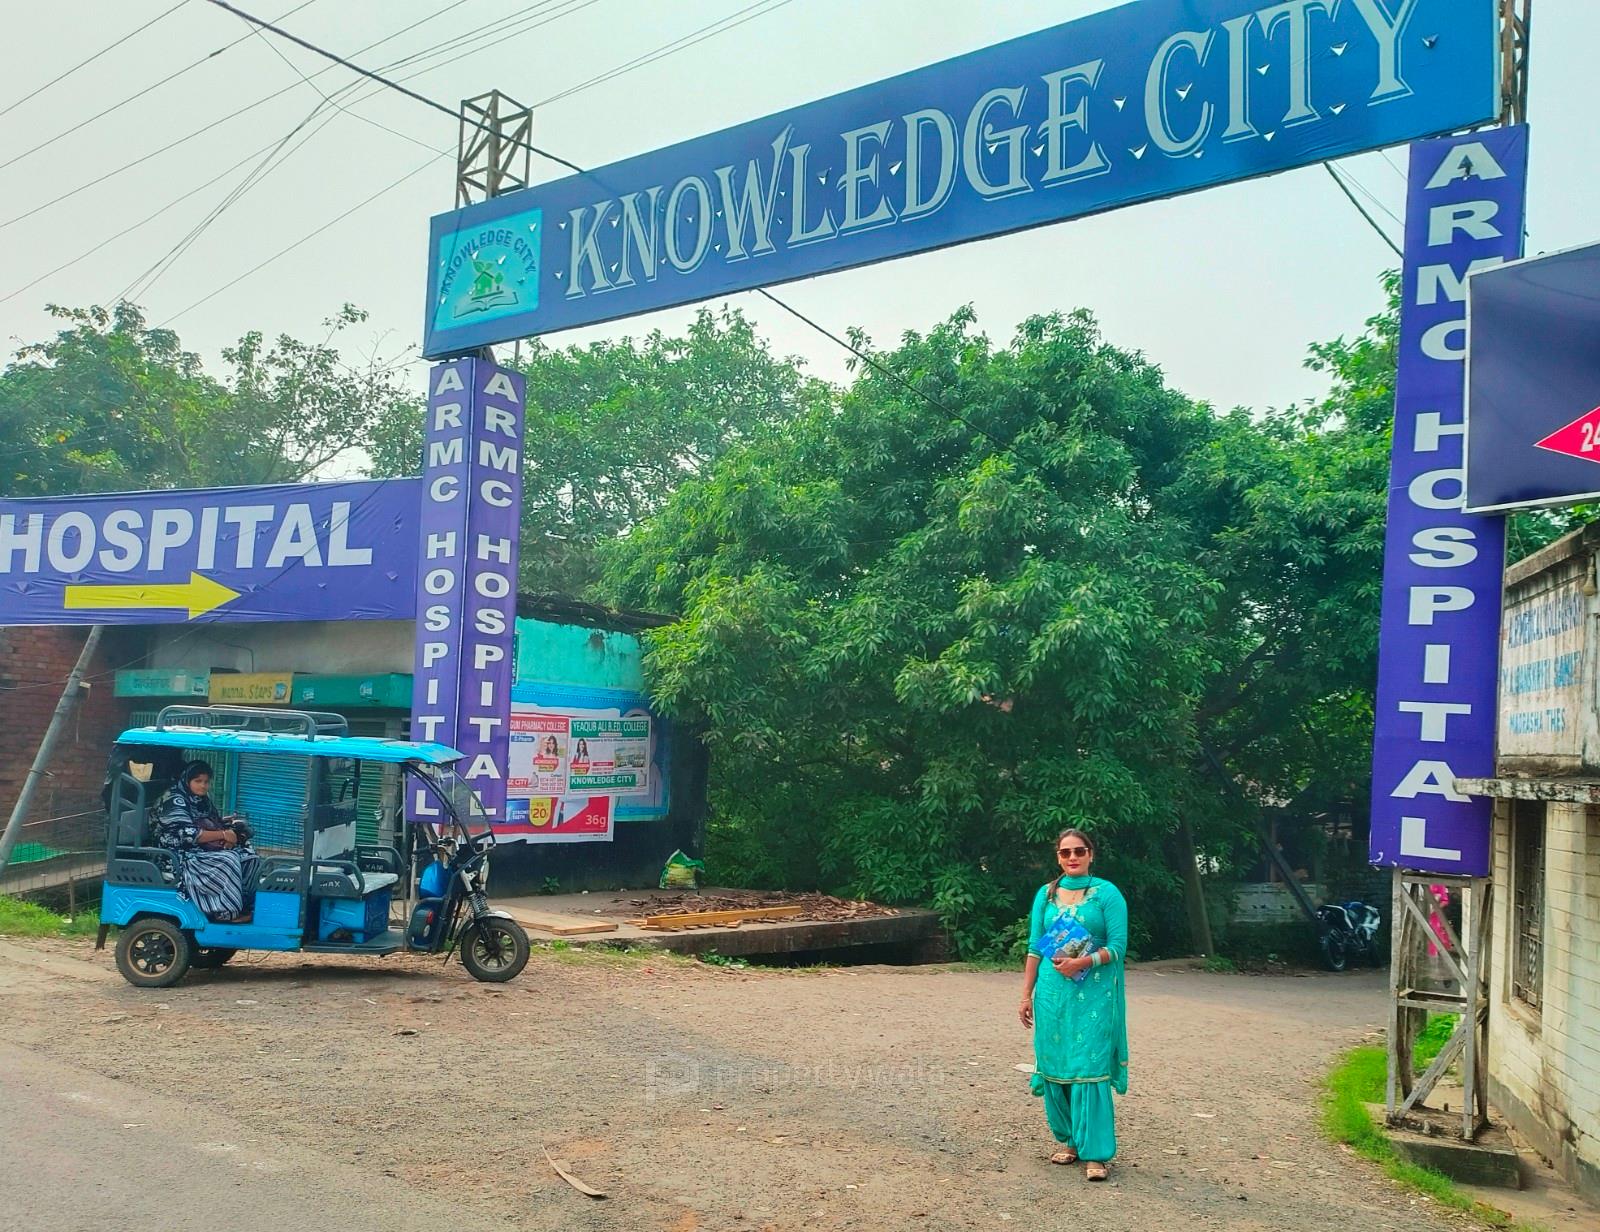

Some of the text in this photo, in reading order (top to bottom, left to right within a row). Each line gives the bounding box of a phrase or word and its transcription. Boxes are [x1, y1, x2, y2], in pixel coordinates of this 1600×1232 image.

[566, 0, 1419, 299] KNOWLEDGE CITY
[441, 229, 537, 295] KNOWLEDGE CITY
[429, 367, 465, 503] ARMC
[0, 501, 373, 574] HOSPITAL
[465, 371, 519, 817] ARMC HOSPITAL
[1390, 411, 1479, 861] HOSPITAL
[521, 720, 547, 731] PHARMACY
[547, 721, 566, 731] COLLEGE
[573, 720, 597, 732] YEAQUB
[623, 720, 647, 732] COLLEGE
[571, 775, 633, 784] KNOWLEDGE CITY
[532, 808, 547, 818] 20
[585, 815, 606, 828] 36g
